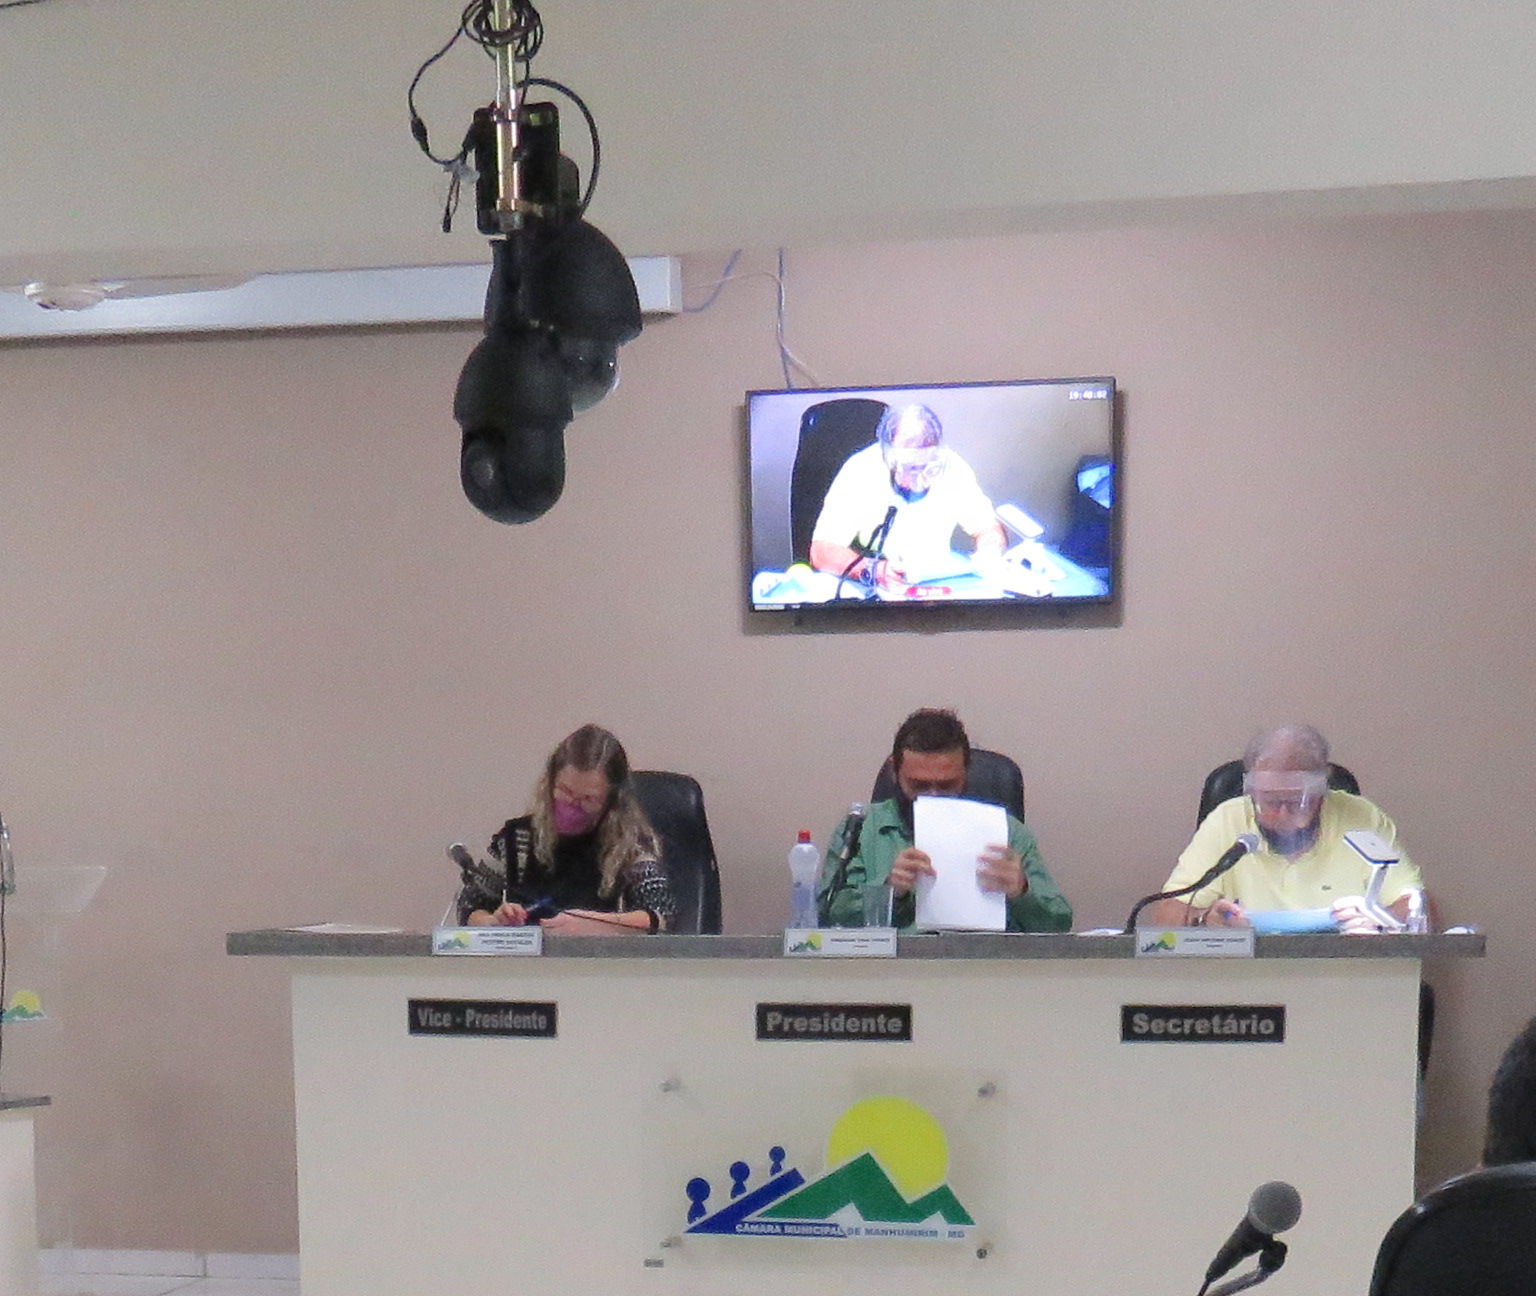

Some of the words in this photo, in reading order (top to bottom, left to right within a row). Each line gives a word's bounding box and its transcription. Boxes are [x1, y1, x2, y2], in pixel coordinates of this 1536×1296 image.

[417, 1007, 452, 1027] Vice
[466, 1008, 547, 1030] Presidente
[766, 1011, 903, 1034] Presidente
[1132, 1012, 1275, 1035] Secretário
[784, 1224, 844, 1236] MUNICIPAL
[847, 1227, 861, 1236] DE
